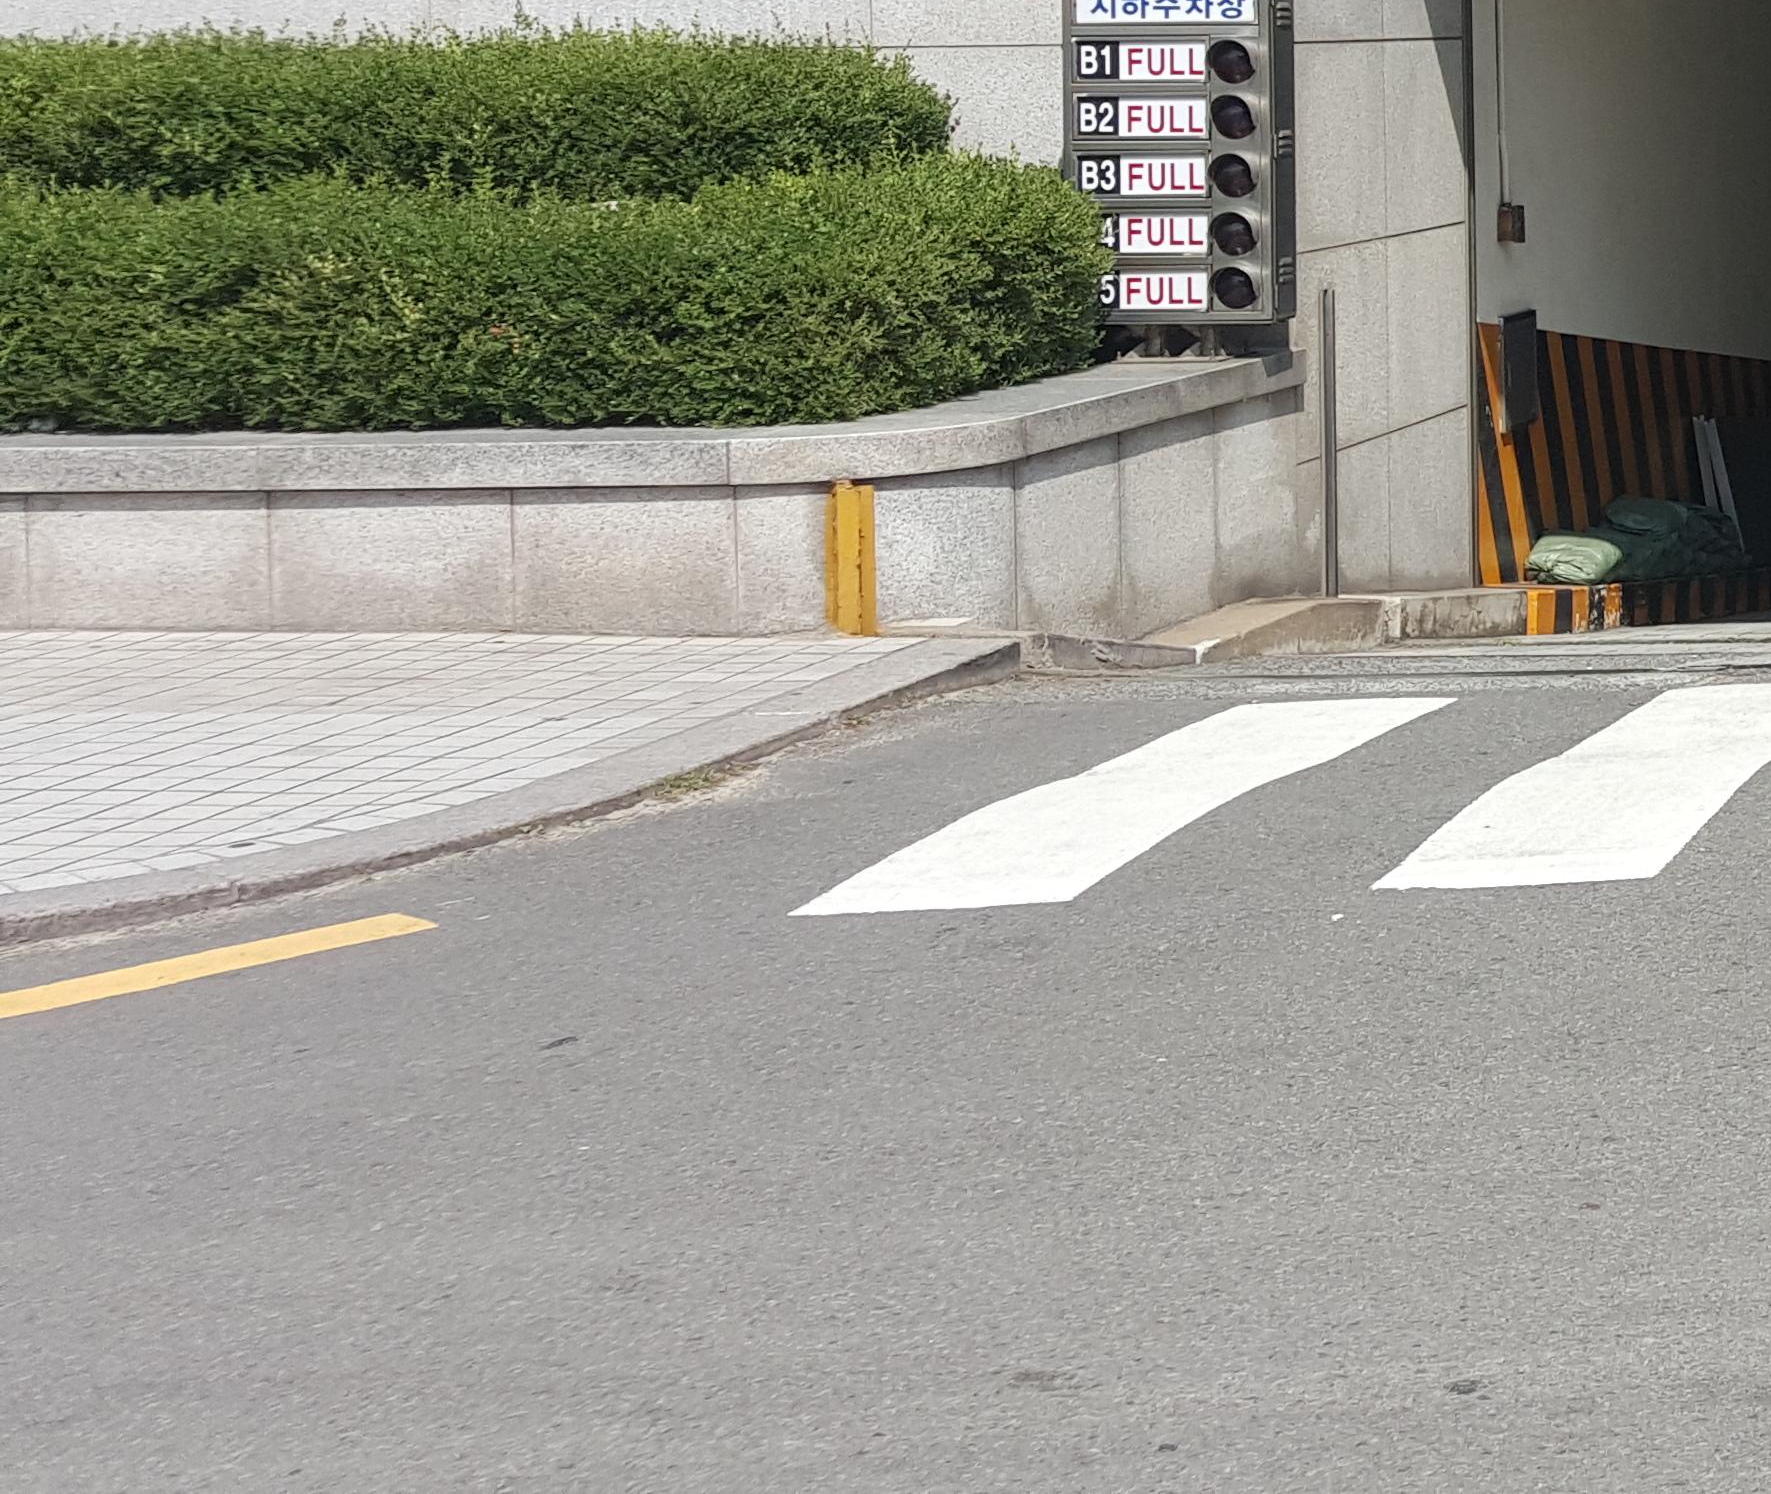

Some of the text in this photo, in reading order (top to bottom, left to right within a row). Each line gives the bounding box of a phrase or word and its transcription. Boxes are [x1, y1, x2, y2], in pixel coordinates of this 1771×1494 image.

[1080, 45, 1205, 76] B1 FULL
[1079, 102, 1204, 134] B2 FULL
[1081, 159, 1205, 192] B3 FULL
[1126, 217, 1204, 247] FULL
[1100, 274, 1203, 305] 5 FULL
